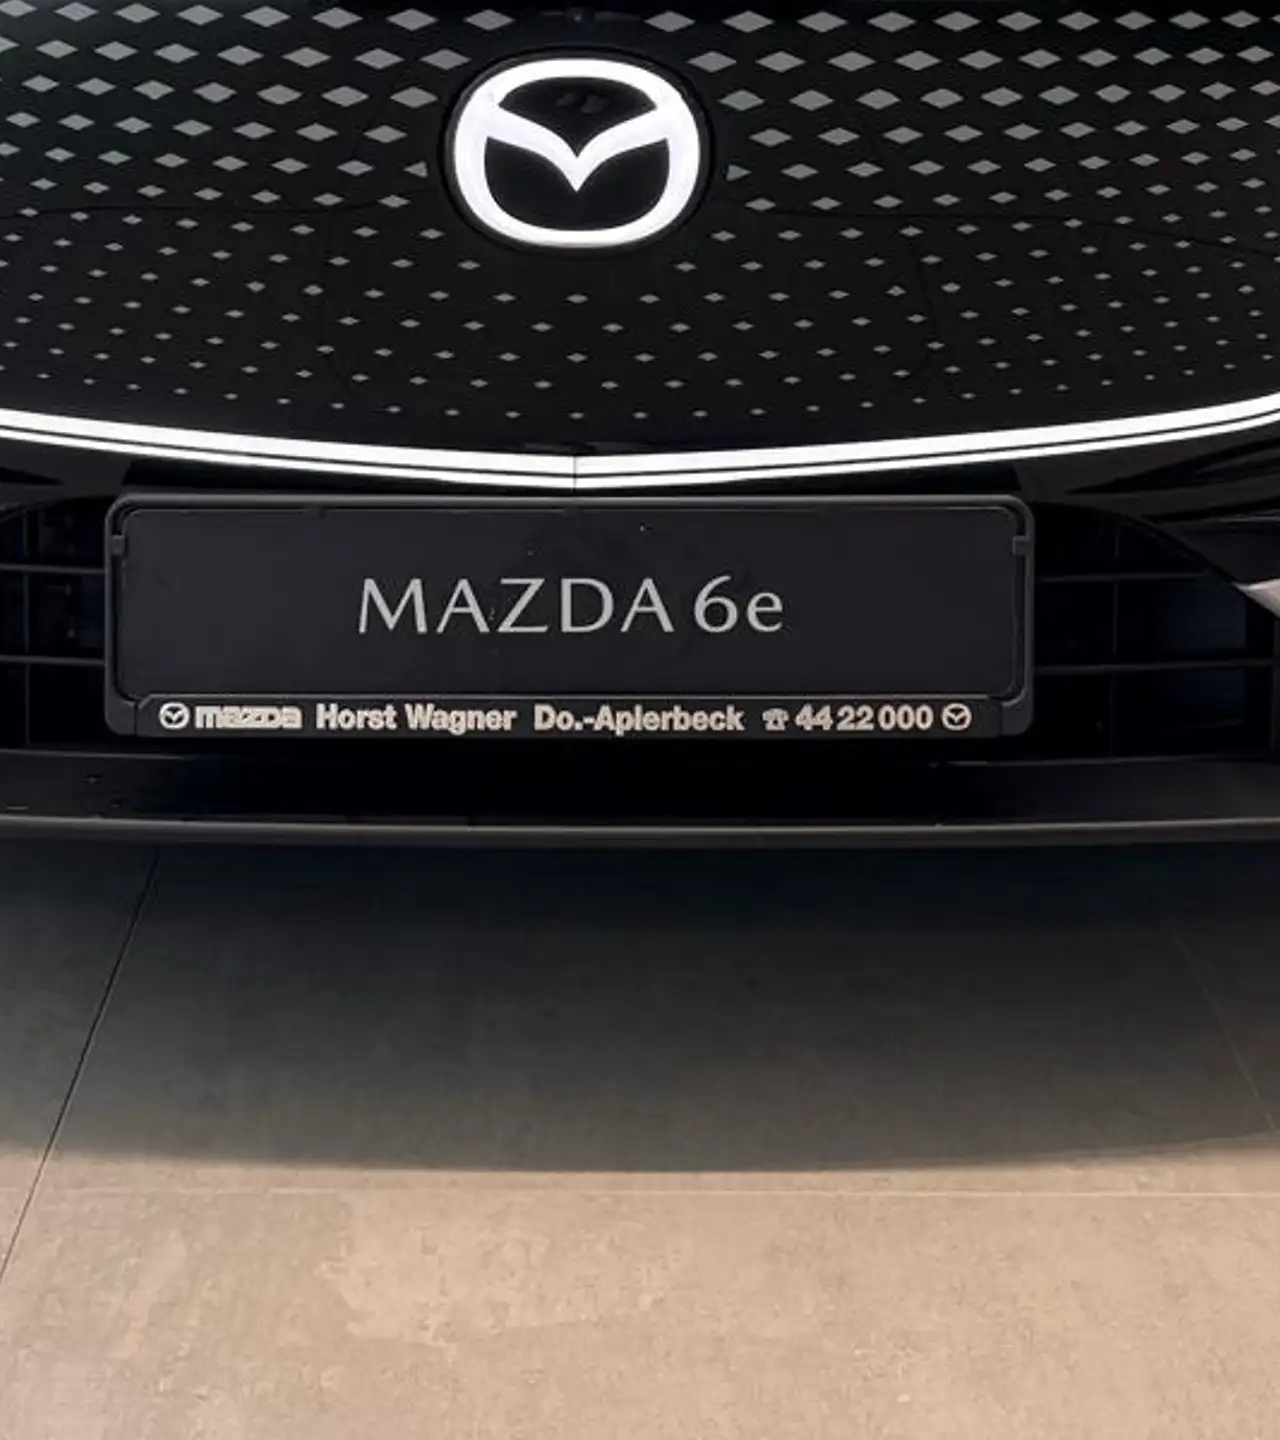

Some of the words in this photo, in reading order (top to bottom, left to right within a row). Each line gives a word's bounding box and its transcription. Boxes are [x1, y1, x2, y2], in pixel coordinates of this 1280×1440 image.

[358, 577, 674, 634] MAZDA
[694, 575, 783, 633] 6e
[316, 703, 397, 730] Horst
[404, 703, 518, 736] Wagner
[533, 703, 745, 736] Do.-Aplerbeck
